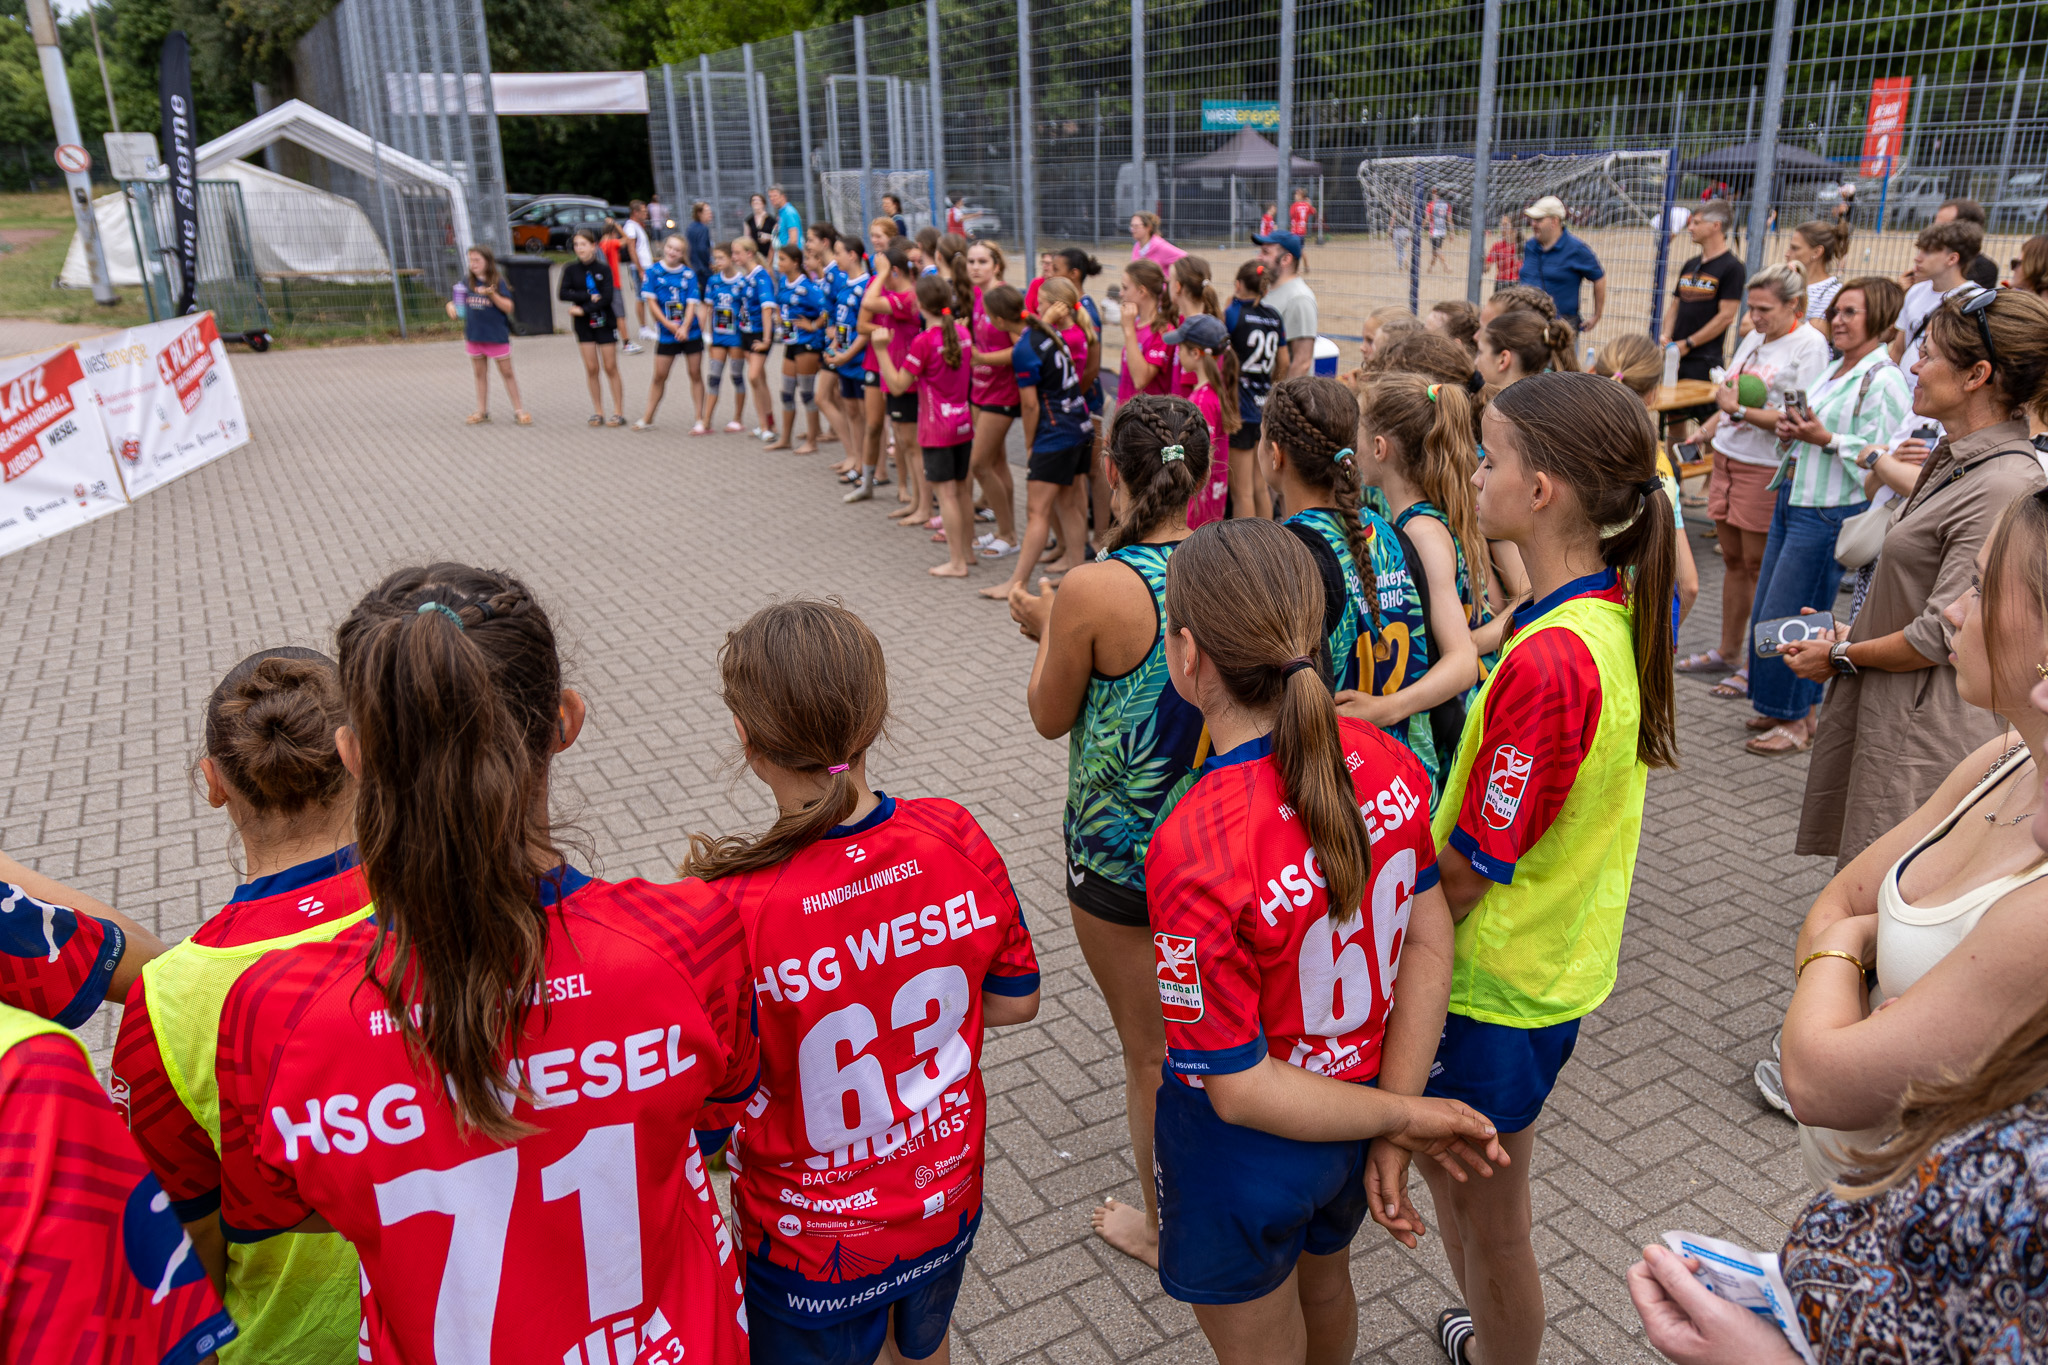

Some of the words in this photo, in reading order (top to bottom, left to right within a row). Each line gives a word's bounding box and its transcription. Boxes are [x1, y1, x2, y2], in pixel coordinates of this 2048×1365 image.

[1204, 106, 1280, 128] westenergi
[171, 94, 194, 210] Sterne
[168, 323, 205, 372] PLATZ
[1054, 344, 1079, 390] 2
[1241, 328, 1279, 374] 29
[0, 365, 48, 424] LATZ
[47, 419, 78, 447] WESEL
[7, 444, 39, 479] JUGEND
[1380, 588, 1404, 610] BHC
[1355, 621, 1410, 697] 12
[1360, 775, 1420, 846] ESEL
[1488, 782, 1519, 808] Haball
[802, 859, 922, 915] #HANDBALLINWESEL
[1471, 860, 1489, 874] WESEL
[755, 946, 842, 1008] HSG
[845, 890, 996, 971] WESEL
[1299, 848, 1416, 1037] 66
[799, 965, 971, 1153] 63
[1175, 1062, 1210, 1070] HSGWESEL
[271, 1083, 425, 1161] HSG
[900, 1133, 926, 1156] SEIT
[937, 1160, 960, 1178] Wesel
[779, 1187, 878, 1215] servoprax
[373, 1122, 643, 1365] 71
[779, 1221, 799, 1232] S&K
[806, 1220, 848, 1229] Schmülling
[787, 1231, 971, 1314] WWW.HSG-WESEL.DE
